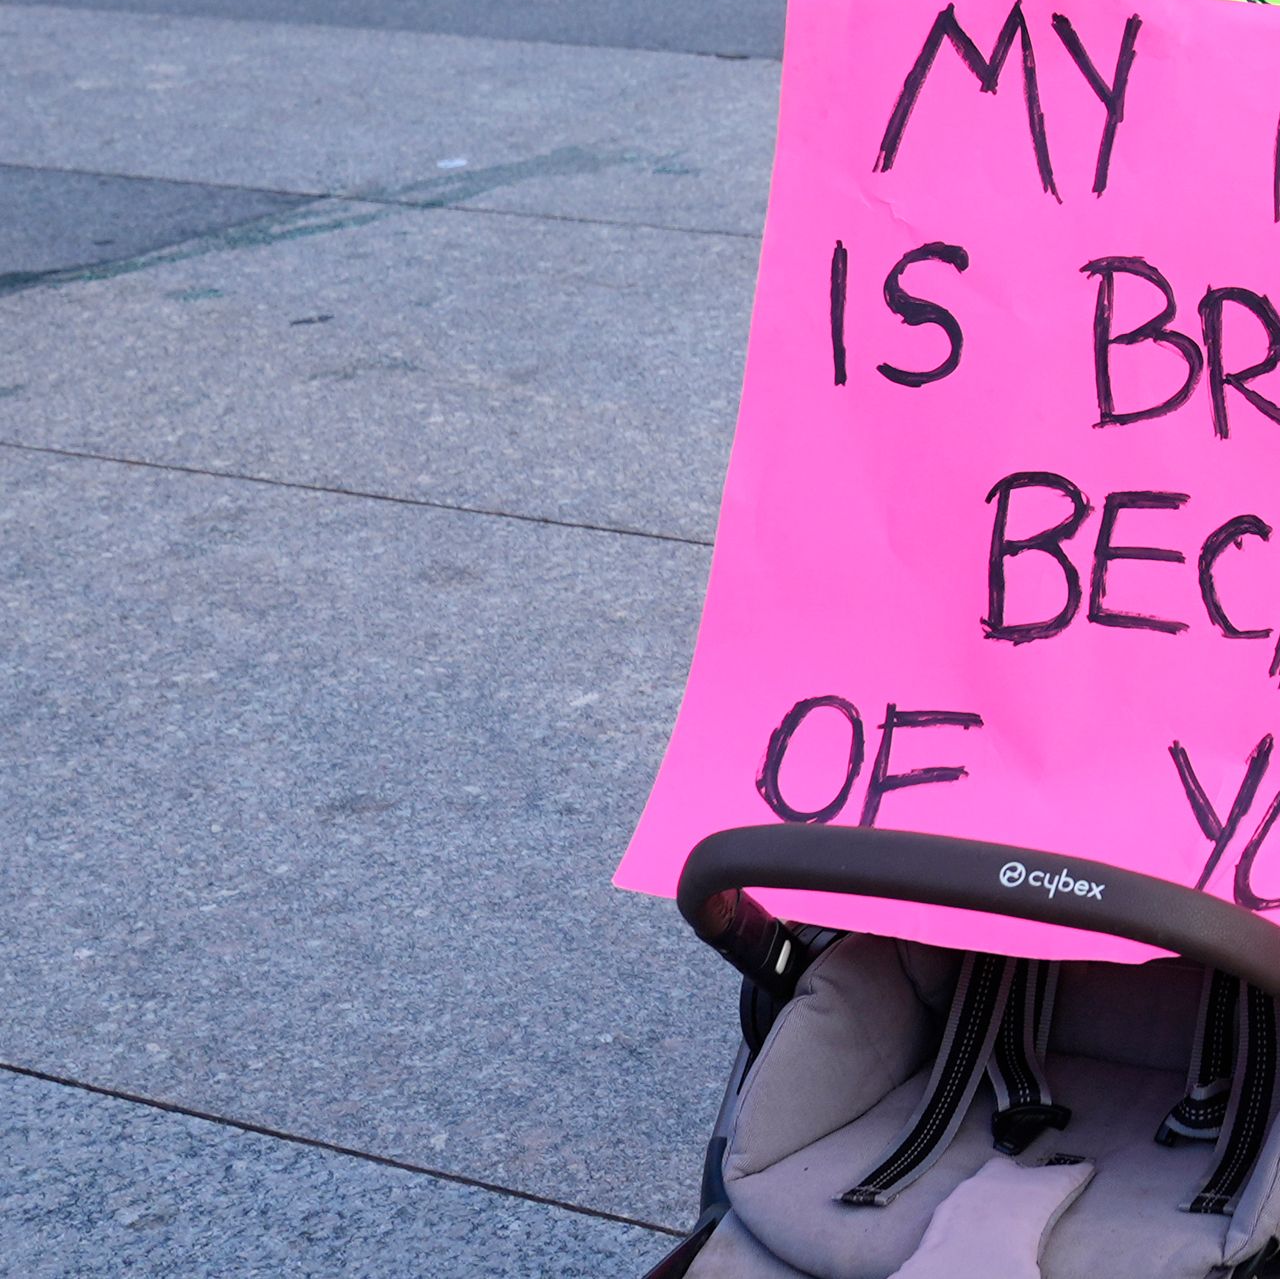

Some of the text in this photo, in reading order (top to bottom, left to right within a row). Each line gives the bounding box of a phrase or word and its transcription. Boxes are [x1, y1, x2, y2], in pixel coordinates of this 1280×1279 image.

[831, 239, 970, 388] IS
[755, 695, 984, 829] OF
[1028, 868, 1106, 901] cybex
